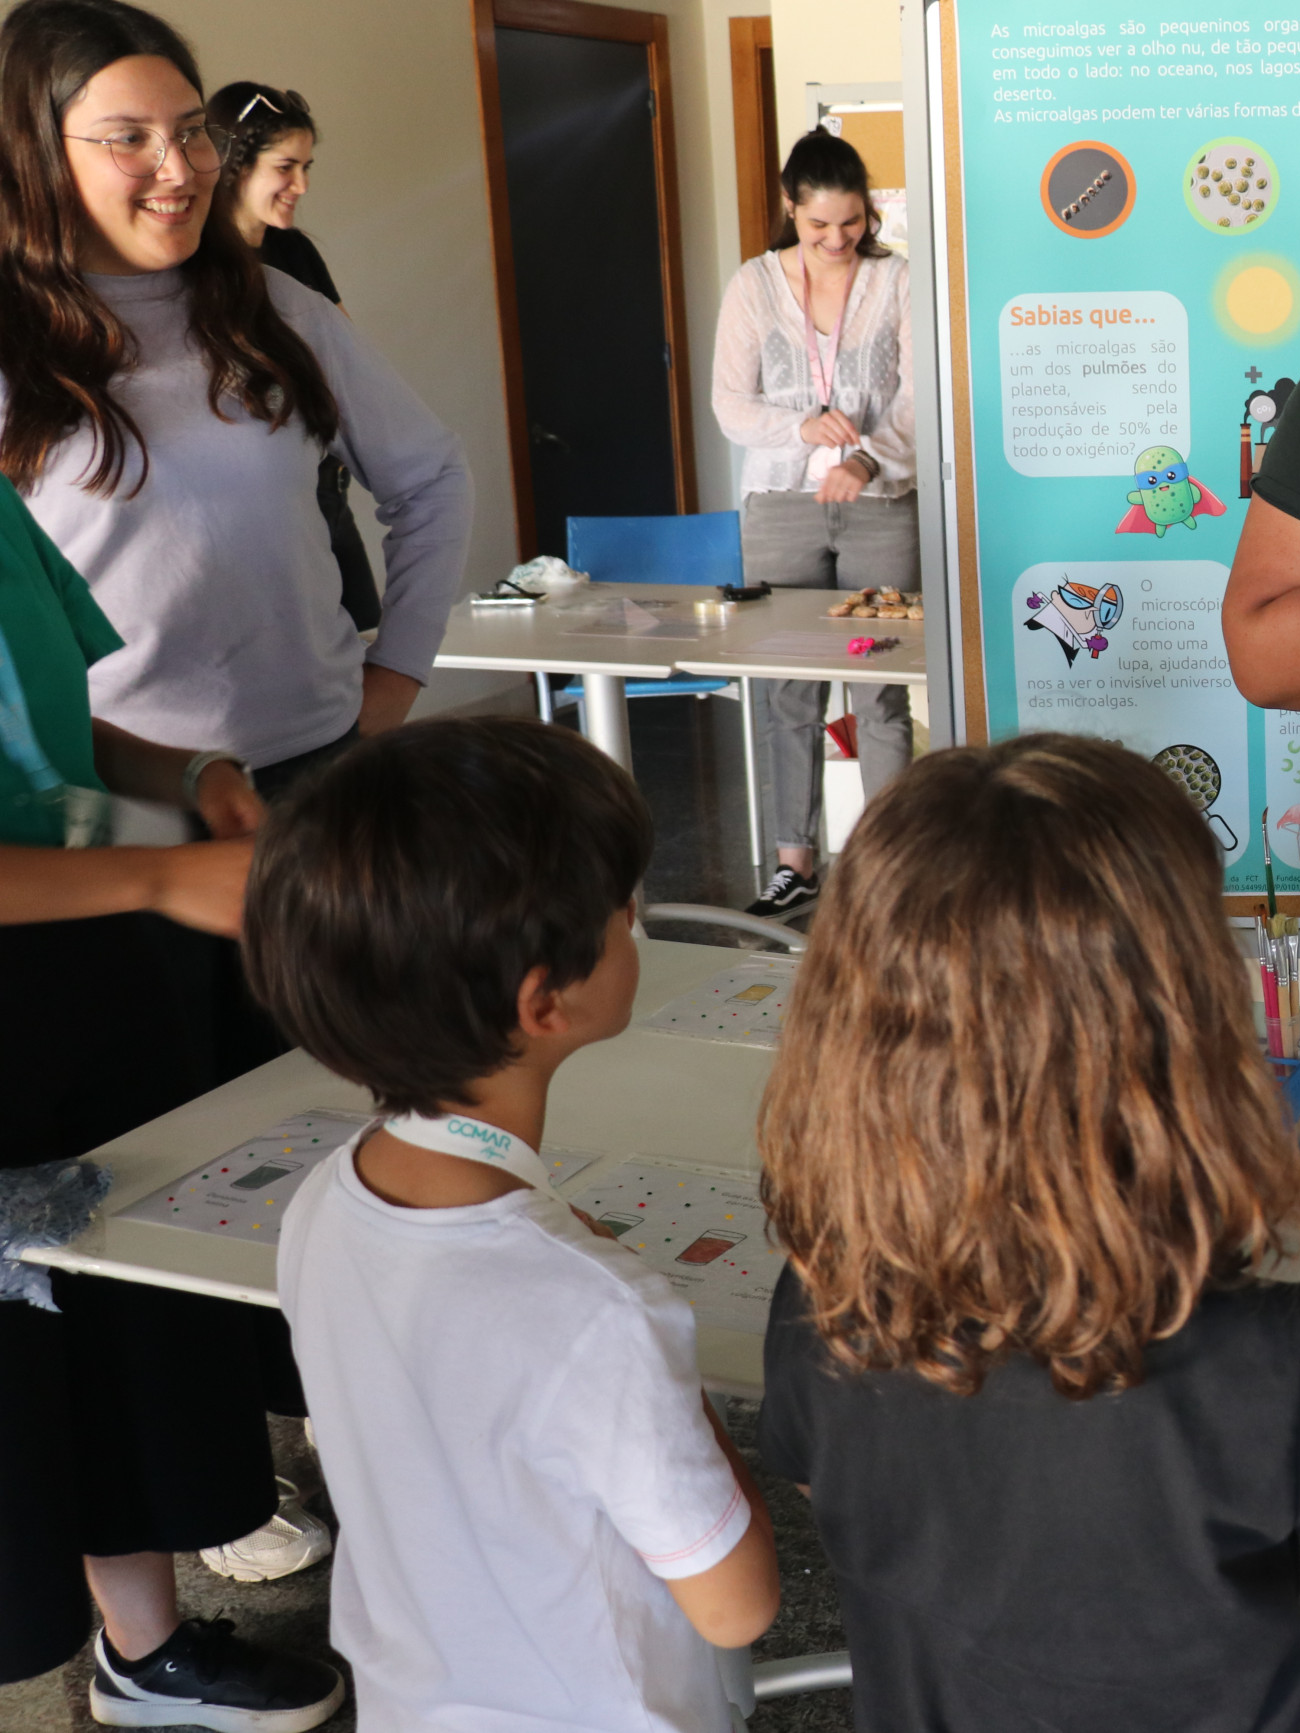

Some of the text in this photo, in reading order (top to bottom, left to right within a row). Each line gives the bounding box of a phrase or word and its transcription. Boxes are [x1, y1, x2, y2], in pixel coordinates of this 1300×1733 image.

[991, 24, 1009, 37] As
[1023, 21, 1106, 39] microalgas
[1120, 20, 1146, 35] são
[1160, 18, 1250, 37] pequeninos
[992, 42, 1092, 61] conseguimos
[1097, 44, 1121, 56] ver
[1127, 44, 1136, 56] a
[1142, 40, 1176, 56] olho
[1182, 42, 1205, 57] nu,
[1211, 39, 1230, 54] de
[1236, 38, 1261, 54] tão
[993, 67, 1016, 80] em
[1024, 65, 1060, 80] todo
[1068, 66, 1078, 79] o
[1086, 63, 1123, 78] lado:
[1130, 64, 1150, 77] no
[1158, 63, 1218, 78] oceano,
[1226, 62, 1253, 75] nos
[993, 87, 1057, 102] deserto.
[994, 109, 1012, 122] As
[1016, 106, 1098, 124] microalgas
[1102, 104, 1155, 122] podem
[1160, 104, 1181, 119] ter
[1186, 103, 1229, 119] várias
[1234, 102, 1287, 117] formas
[1010, 305, 1155, 329] Sabias que...
[1010, 339, 1176, 357] ...as microalgas são
[1010, 360, 1177, 377] um dos pulmões do
[1011, 380, 1177, 399] planeta, sendo
[1012, 400, 1177, 419] responsáveis pela
[1013, 421, 1178, 440] produção de 50% de
[1013, 442, 1136, 459] todo o oxigénio?
[1141, 579, 1152, 592] O
[1142, 597, 1222, 613] microscópi
[1132, 617, 1195, 630] funciona
[1132, 640, 1208, 650] como uma
[1119, 656, 1230, 672] lupa, ajudando-
[1028, 675, 1232, 689] nos a ver o invisível universo
[1029, 694, 1138, 710] das microalgas.
[447, 1119, 511, 1151] CCMAR
